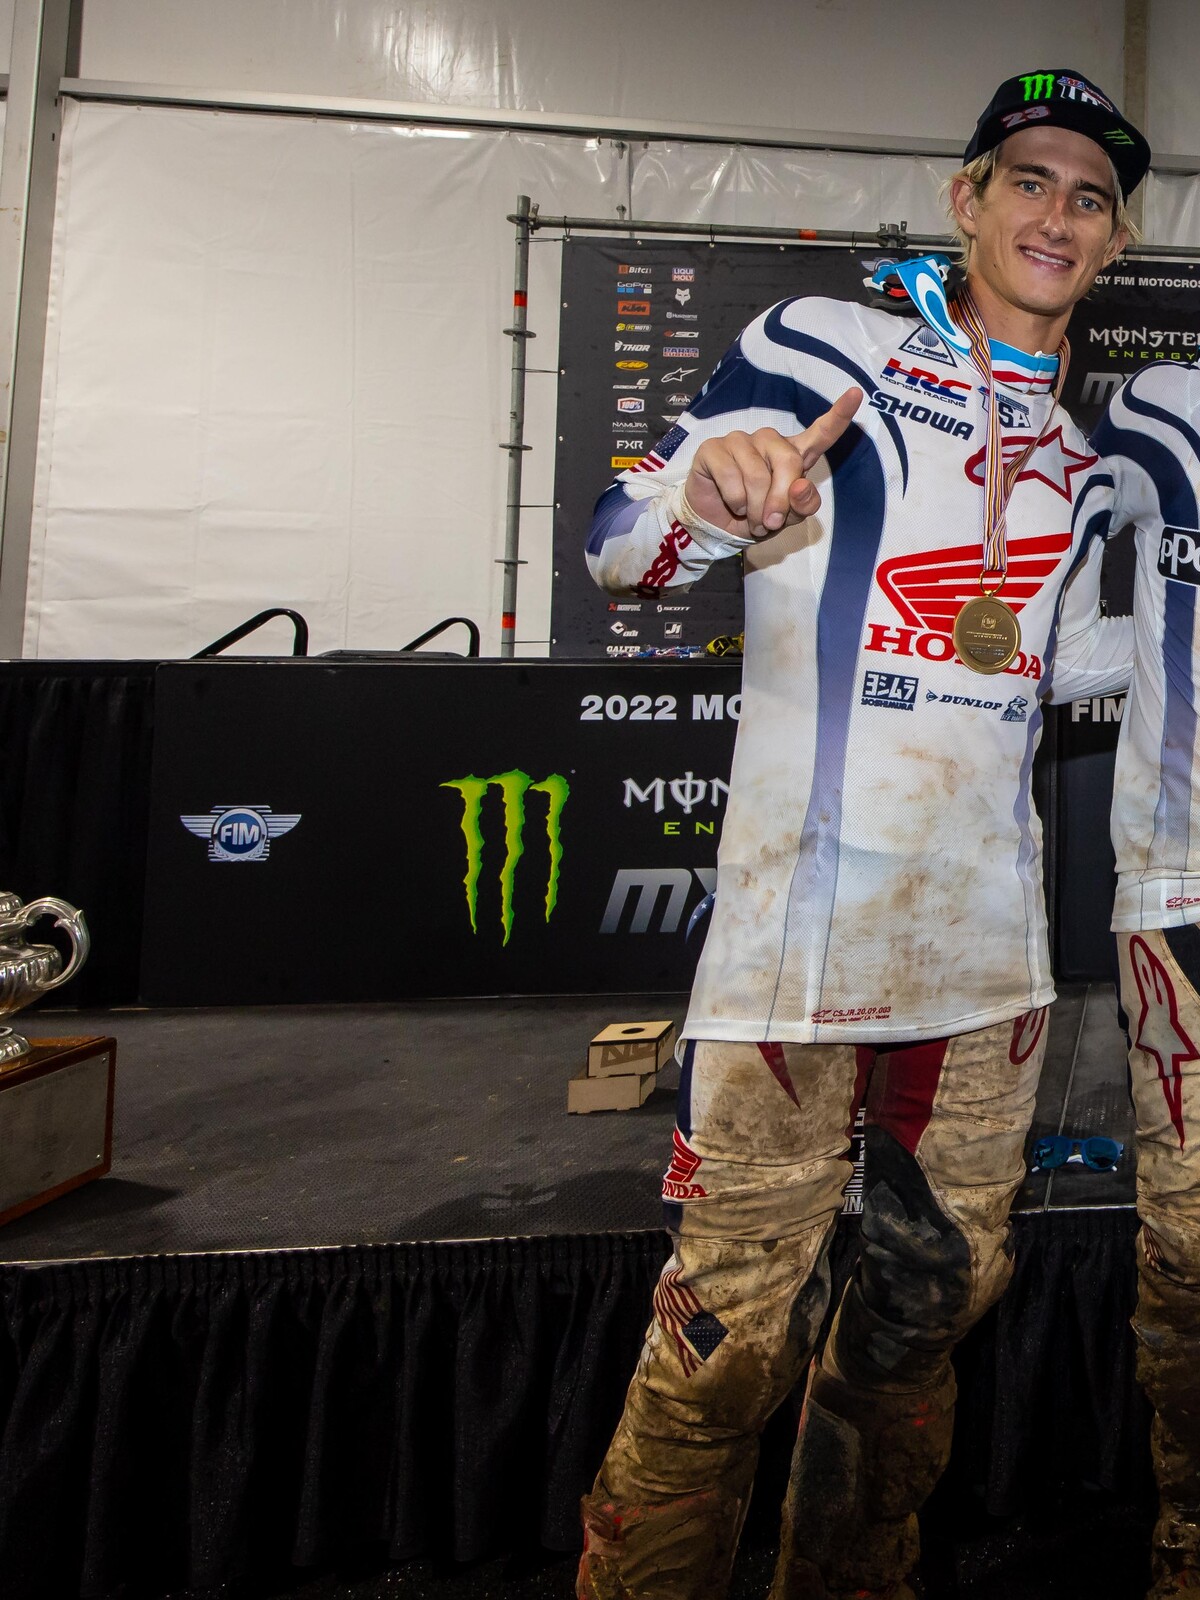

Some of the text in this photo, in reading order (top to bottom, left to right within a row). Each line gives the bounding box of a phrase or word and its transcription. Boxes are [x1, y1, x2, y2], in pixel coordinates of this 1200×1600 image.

[1001, 105, 1050, 128] 23
[1114, 276, 1135, 286] FIM
[623, 343, 650, 351] THOR
[1109, 350, 1195, 360] ENERGY
[880, 357, 972, 403] HRC
[923, 391, 967, 409] RACING
[868, 391, 974, 441] SHOWA
[617, 441, 643, 449] FXR
[865, 624, 1042, 680] HODA
[580, 694, 677, 720] 2022
[861, 697, 914, 711] YOSHIMURA
[939, 694, 1003, 711] DUNLOP
[220, 822, 260, 846] FIM
